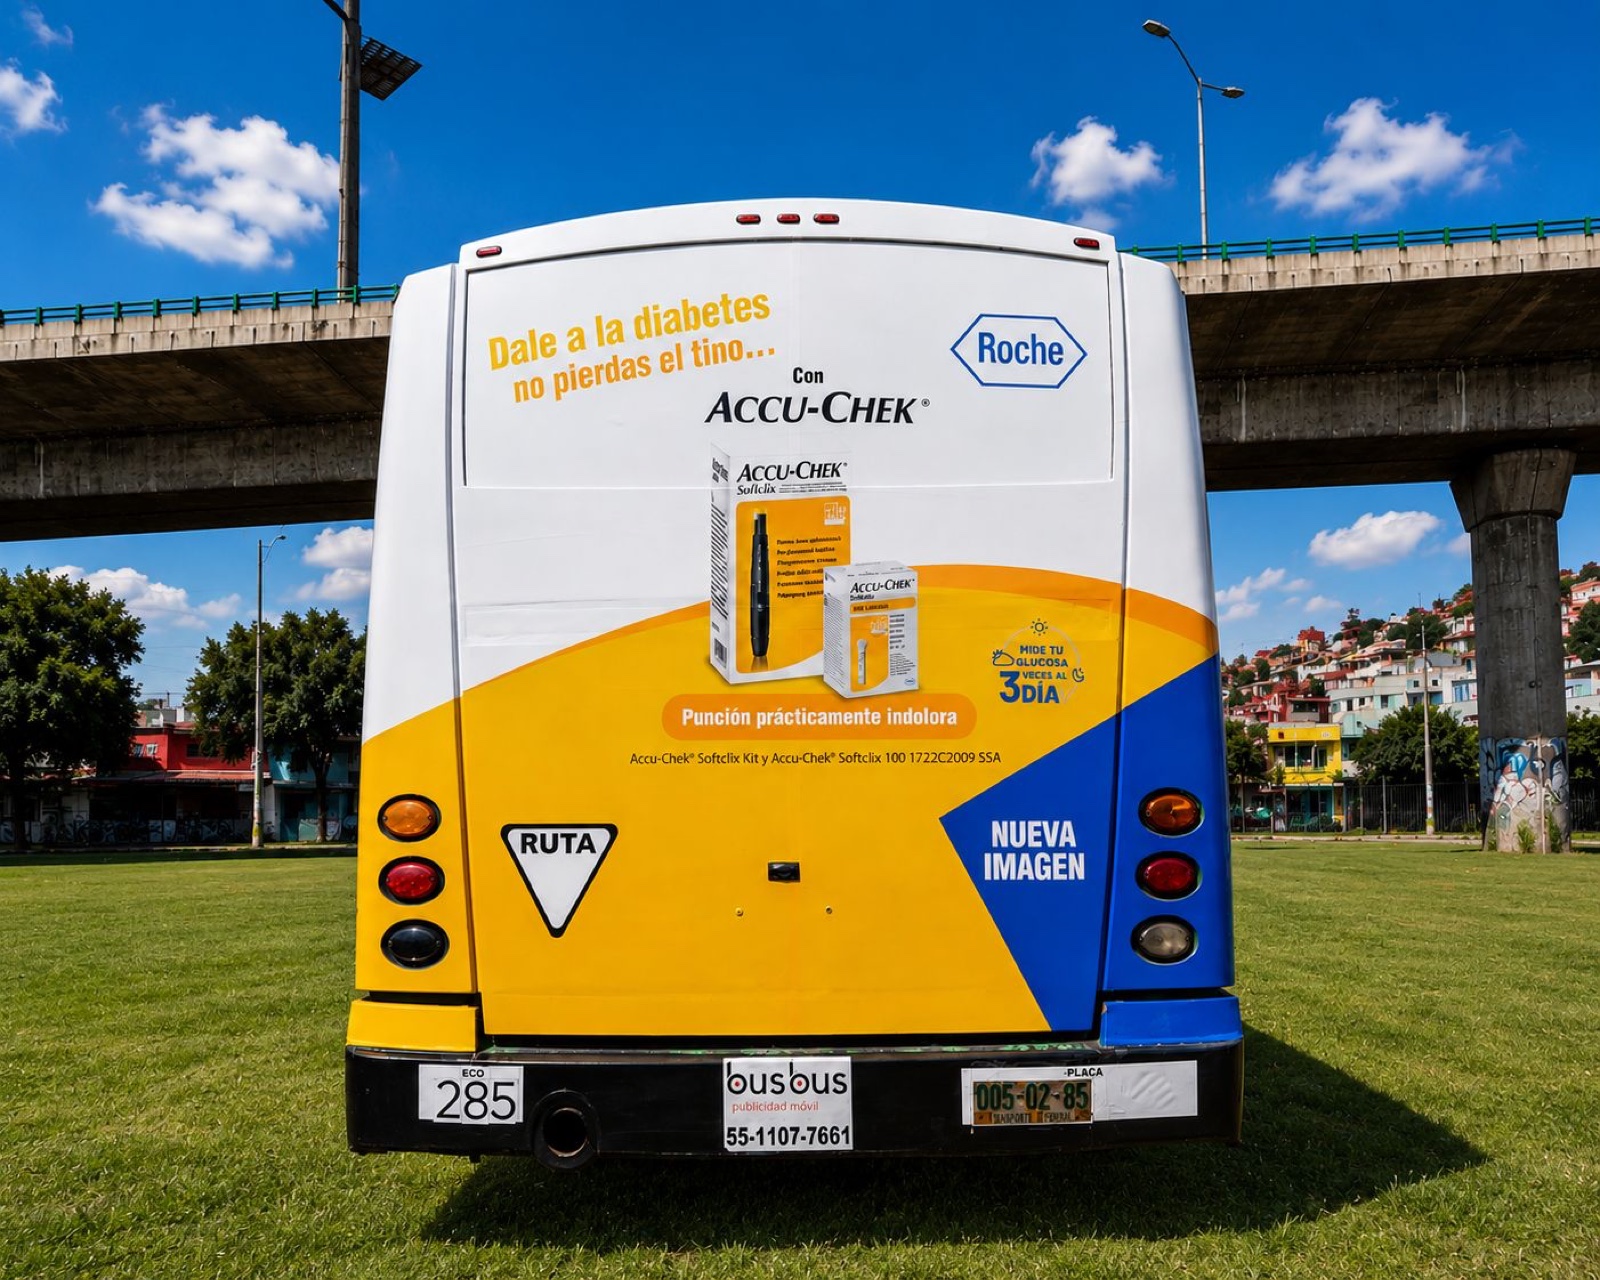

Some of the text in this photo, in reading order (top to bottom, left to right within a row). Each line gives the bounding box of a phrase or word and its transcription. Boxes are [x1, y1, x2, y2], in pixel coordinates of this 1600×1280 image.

[488, 293, 771, 370] Dale a la diabetes
[978, 331, 1064, 365] Roche
[513, 375, 545, 403] no
[553, 355, 652, 402] pierdas
[659, 343, 683, 373] el
[792, 366, 824, 384] Con
[1019, 645, 1064, 655] MIDE TU
[1016, 658, 1069, 667] GLUCOSA
[999, 671, 1067, 703] 3 VECES AL
[1022, 680, 1060, 703] DÍA
[682, 707, 957, 729] Punción prácticamente indolora
[698, 753, 740, 764] Softclix
[743, 753, 759, 764] Kit
[761, 755, 769, 767] y
[838, 752, 882, 763] Softclix
[886, 752, 906, 763] 100
[910, 752, 976, 763] 1722C2009
[979, 752, 1002, 763] SSA
[521, 833, 597, 854] RUTA
[991, 820, 1077, 848] NUEVA
[984, 852, 1085, 880] IMAGEN
[462, 1069, 485, 1077] ECO
[726, 1061, 848, 1095] busbus
[1067, 1067, 1104, 1077] PLACA
[436, 1080, 516, 1120] 285
[732, 1101, 819, 1113] publicidad móvil
[726, 1125, 849, 1146] 55-1107-7661
